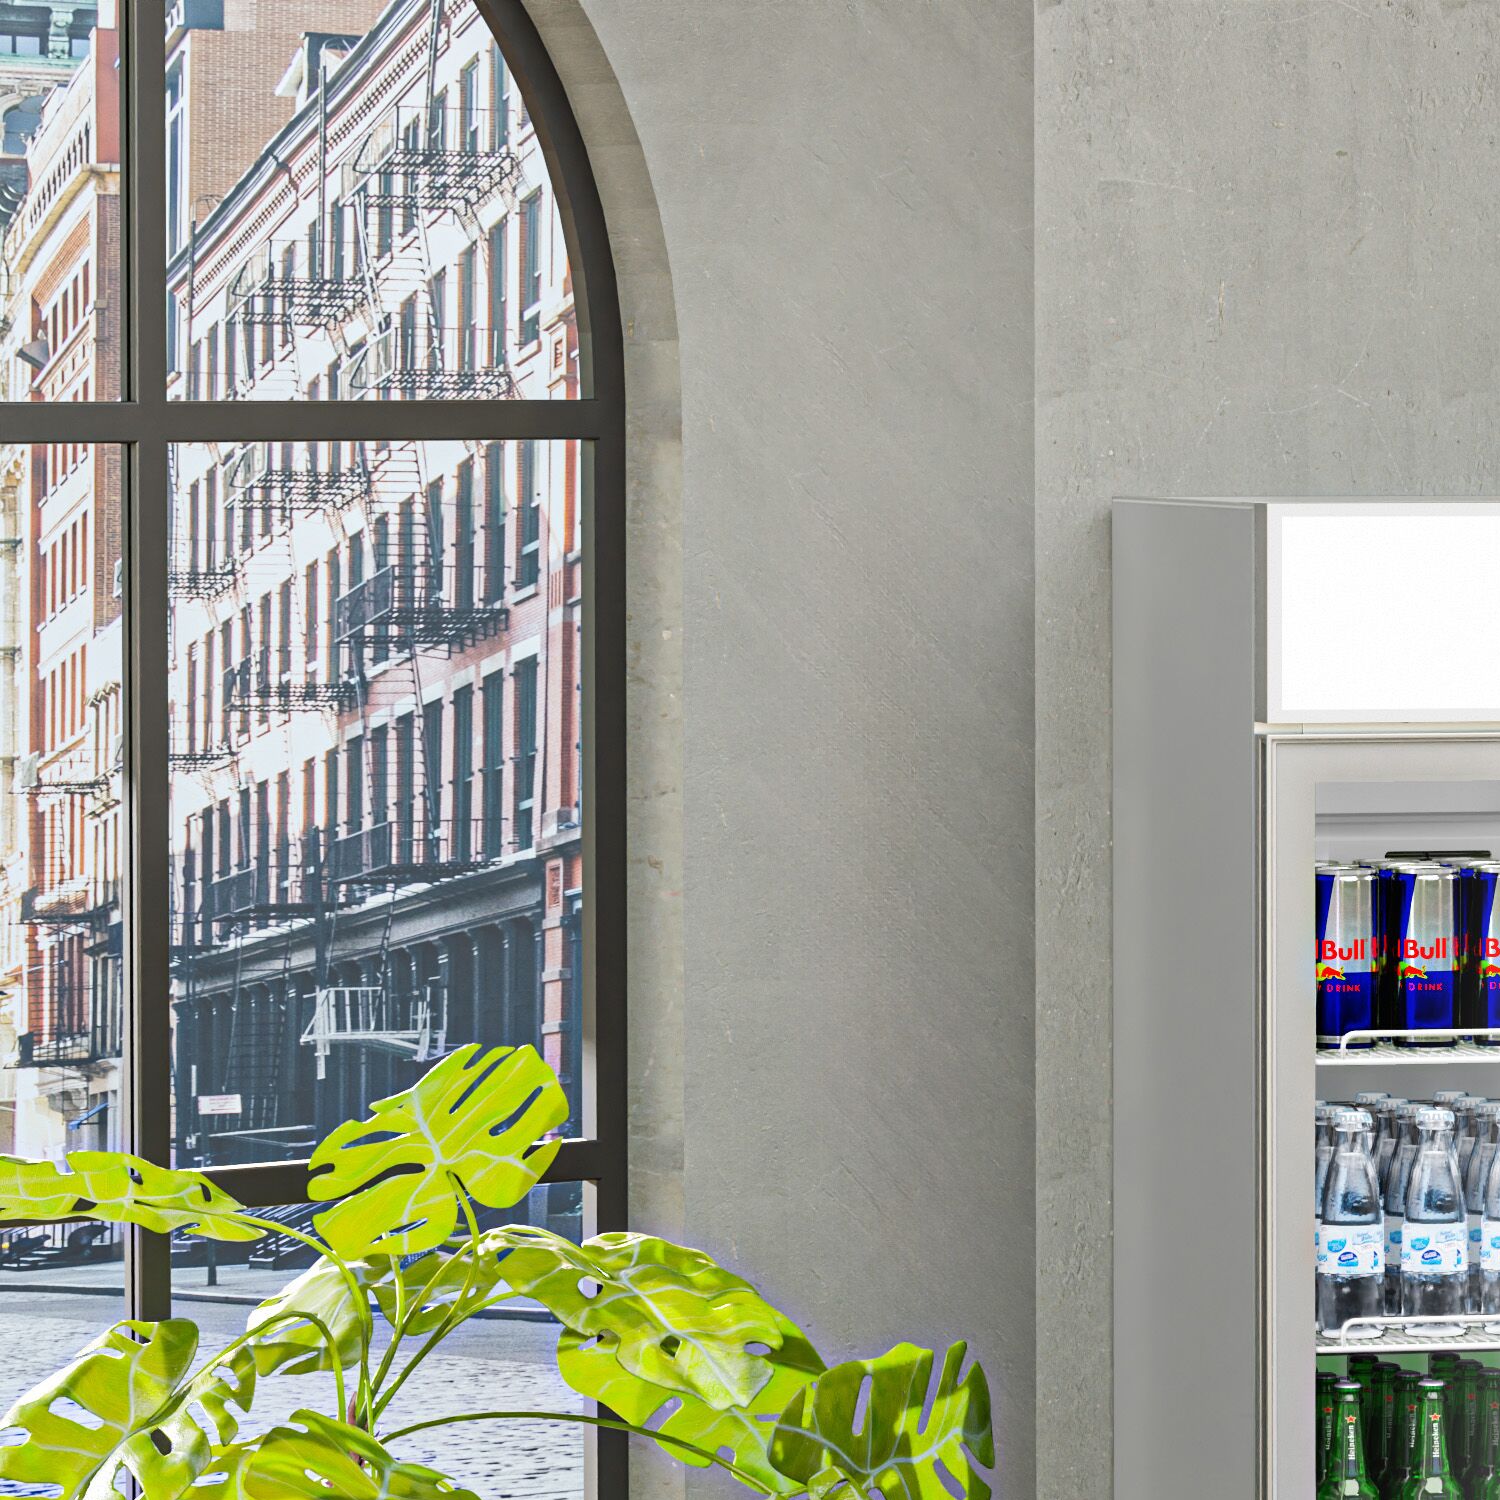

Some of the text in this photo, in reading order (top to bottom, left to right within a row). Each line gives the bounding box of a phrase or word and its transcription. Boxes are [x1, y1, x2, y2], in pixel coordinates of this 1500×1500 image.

[1322, 938, 1365, 961] Bull
[1403, 937, 1447, 960] Bull
[1326, 984, 1361, 993] DRINK
[1408, 982, 1443, 992] DRINK
[1348, 1425, 1356, 1460] Heineken
[1432, 1422, 1440, 1458] Heineken
